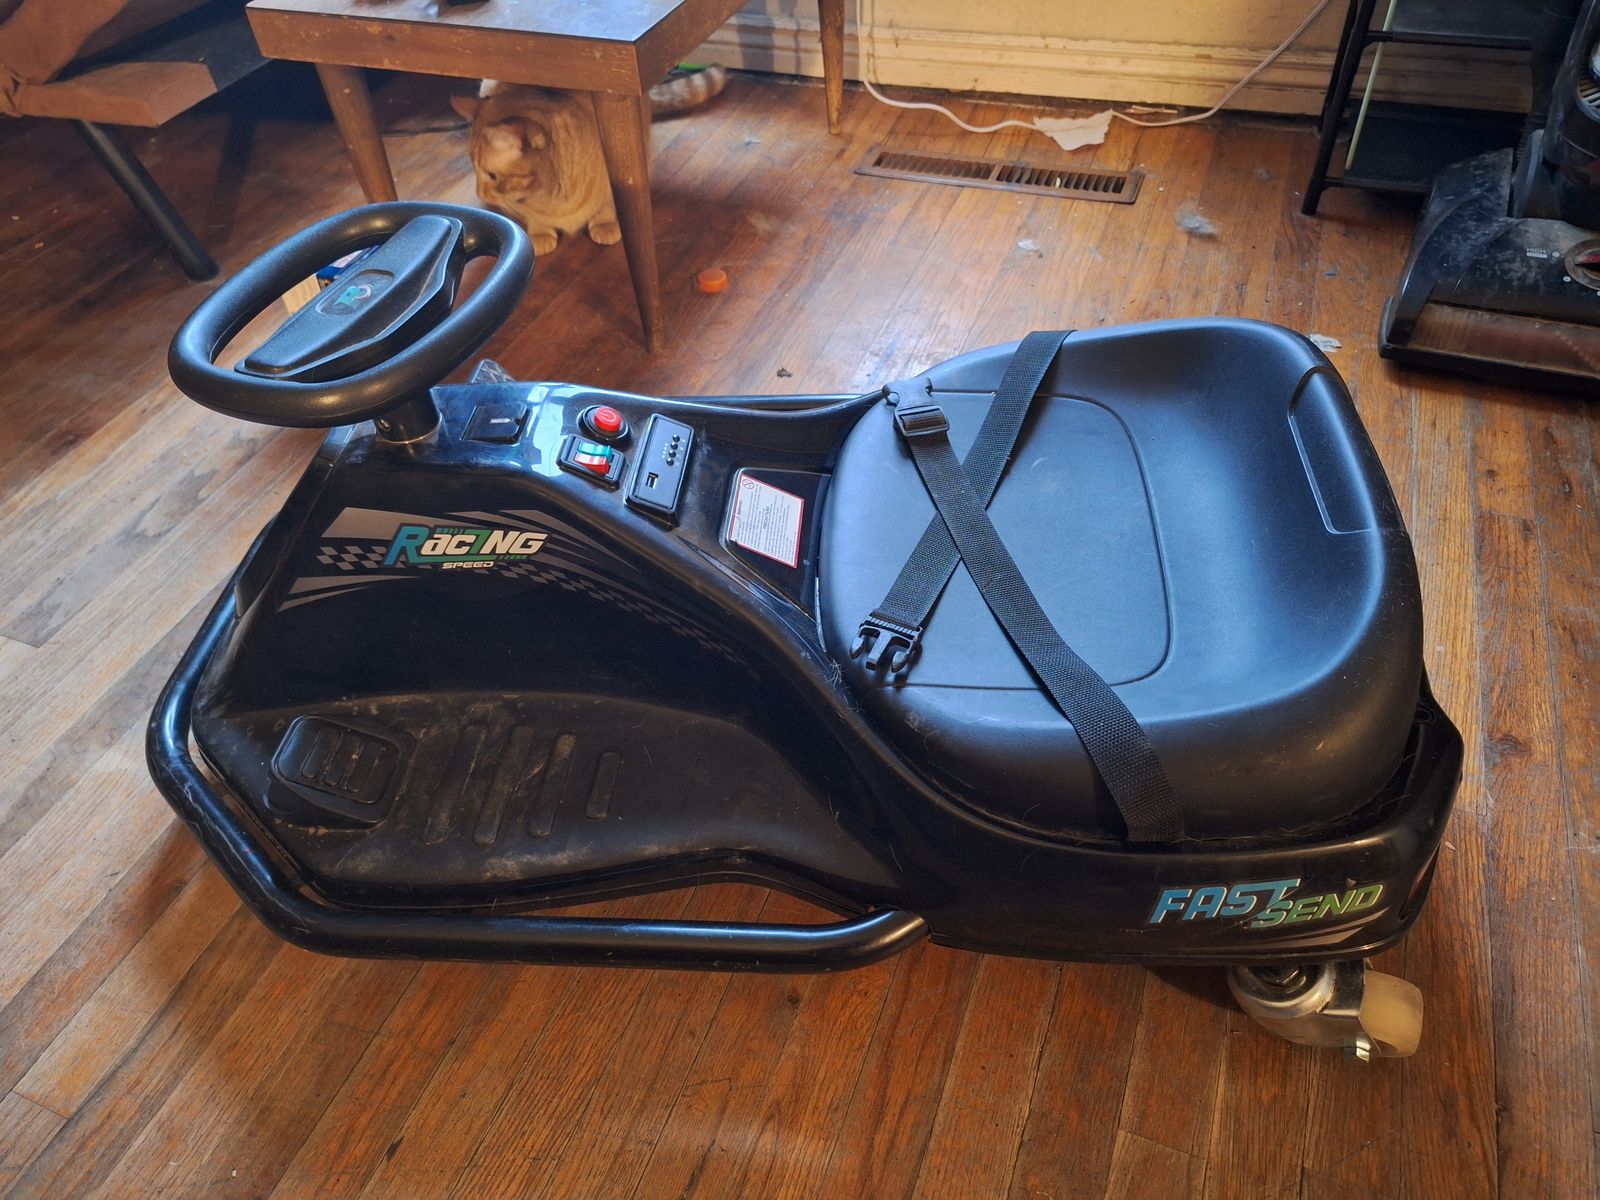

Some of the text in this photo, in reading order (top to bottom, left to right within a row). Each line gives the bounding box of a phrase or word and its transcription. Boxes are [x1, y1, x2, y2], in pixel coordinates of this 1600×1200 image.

[442, 560, 495, 570] SPEED
[1149, 878, 1301, 923] FAST
[1252, 884, 1384, 929] SEND
